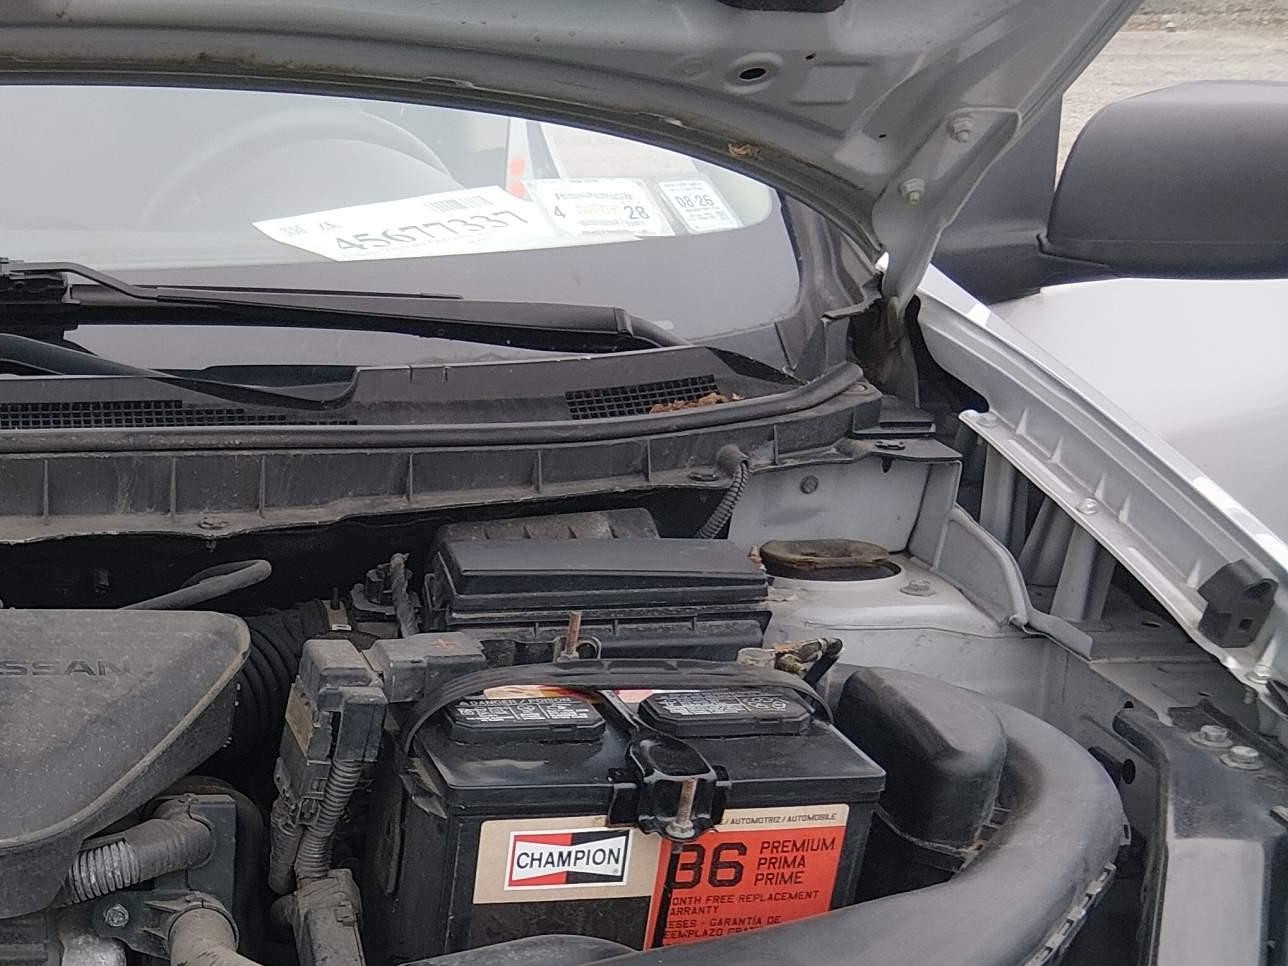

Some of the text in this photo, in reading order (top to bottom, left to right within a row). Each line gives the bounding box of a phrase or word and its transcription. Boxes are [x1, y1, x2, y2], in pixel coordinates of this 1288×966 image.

[553, 205, 566, 219] 4
[624, 205, 650, 220] 28
[336, 210, 529, 250] 45677337
[786, 812, 838, 823] AUTOMOBILE
[759, 837, 835, 855] PREMIUM
[516, 847, 621, 869] CHAMPION
[756, 854, 806, 871] PRIMA
[754, 871, 805, 886] PRIME
[671, 890, 820, 906] ONTH FREE REPLACEMENT
[669, 905, 720, 916] ARRANTY
[666, 919, 697, 929] ESES
[710, 914, 762, 927] GARANTÍA
[766, 915, 782, 925] DE
